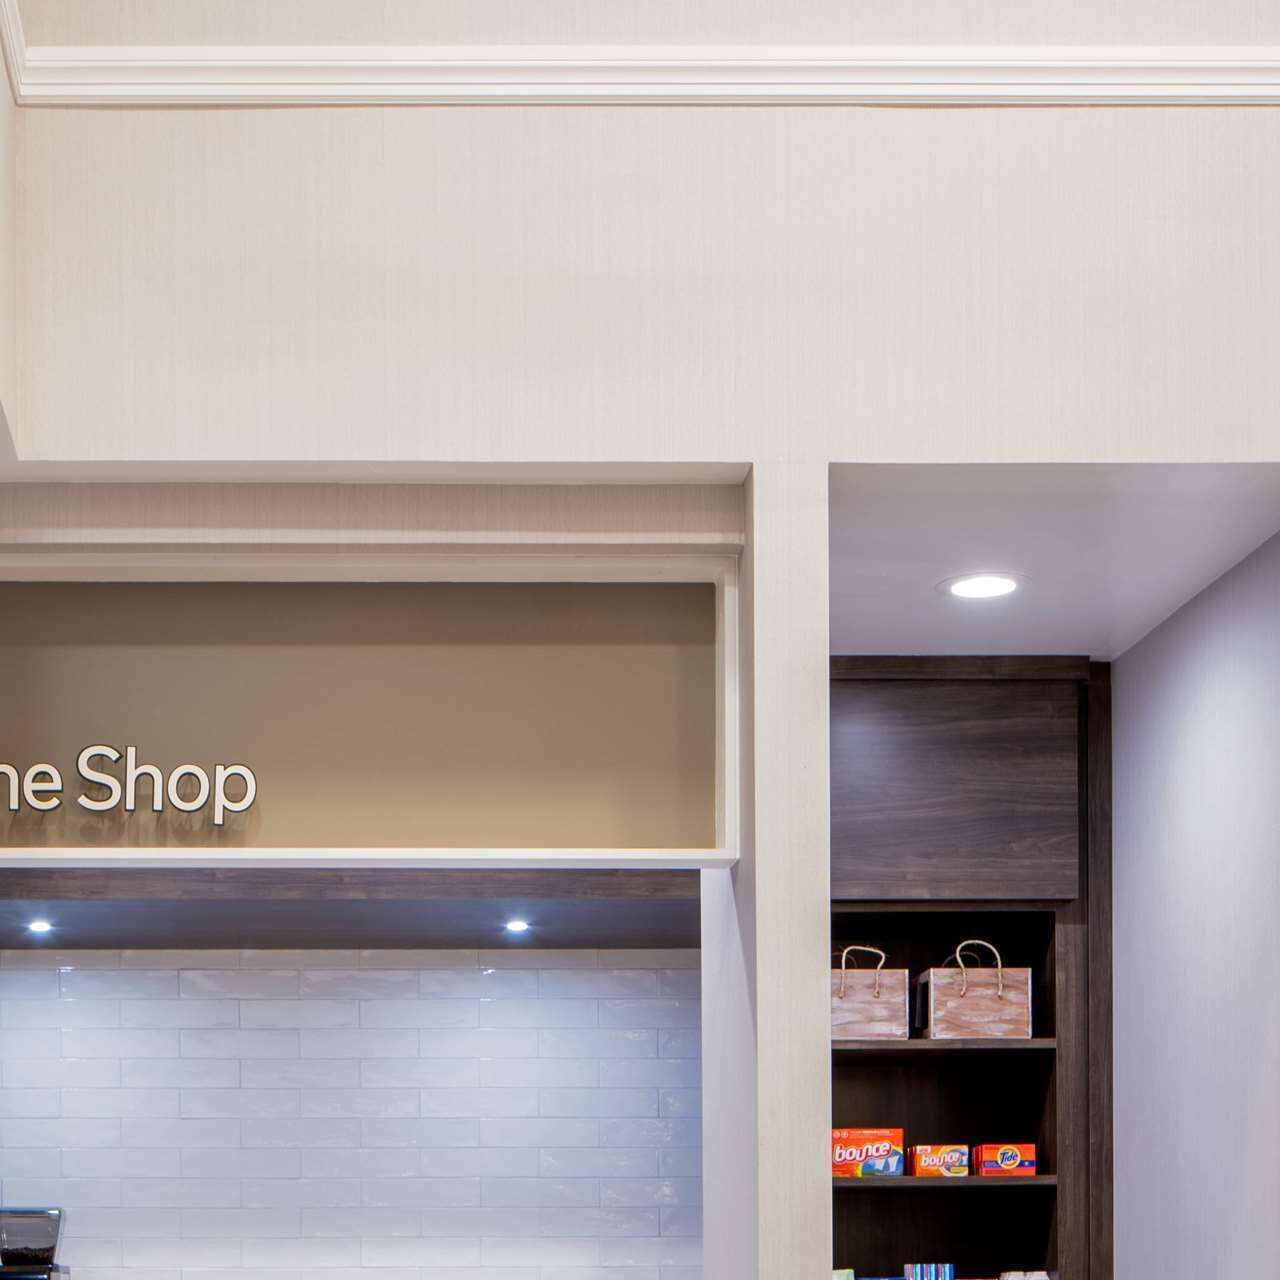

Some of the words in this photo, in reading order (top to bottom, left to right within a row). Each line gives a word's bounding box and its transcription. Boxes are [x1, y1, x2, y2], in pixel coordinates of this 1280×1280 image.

[76, 744, 257, 826] Shop
[833, 1142, 891, 1164] bounce
[921, 1151, 961, 1167] bounce
[999, 1151, 1019, 1165] Tide
